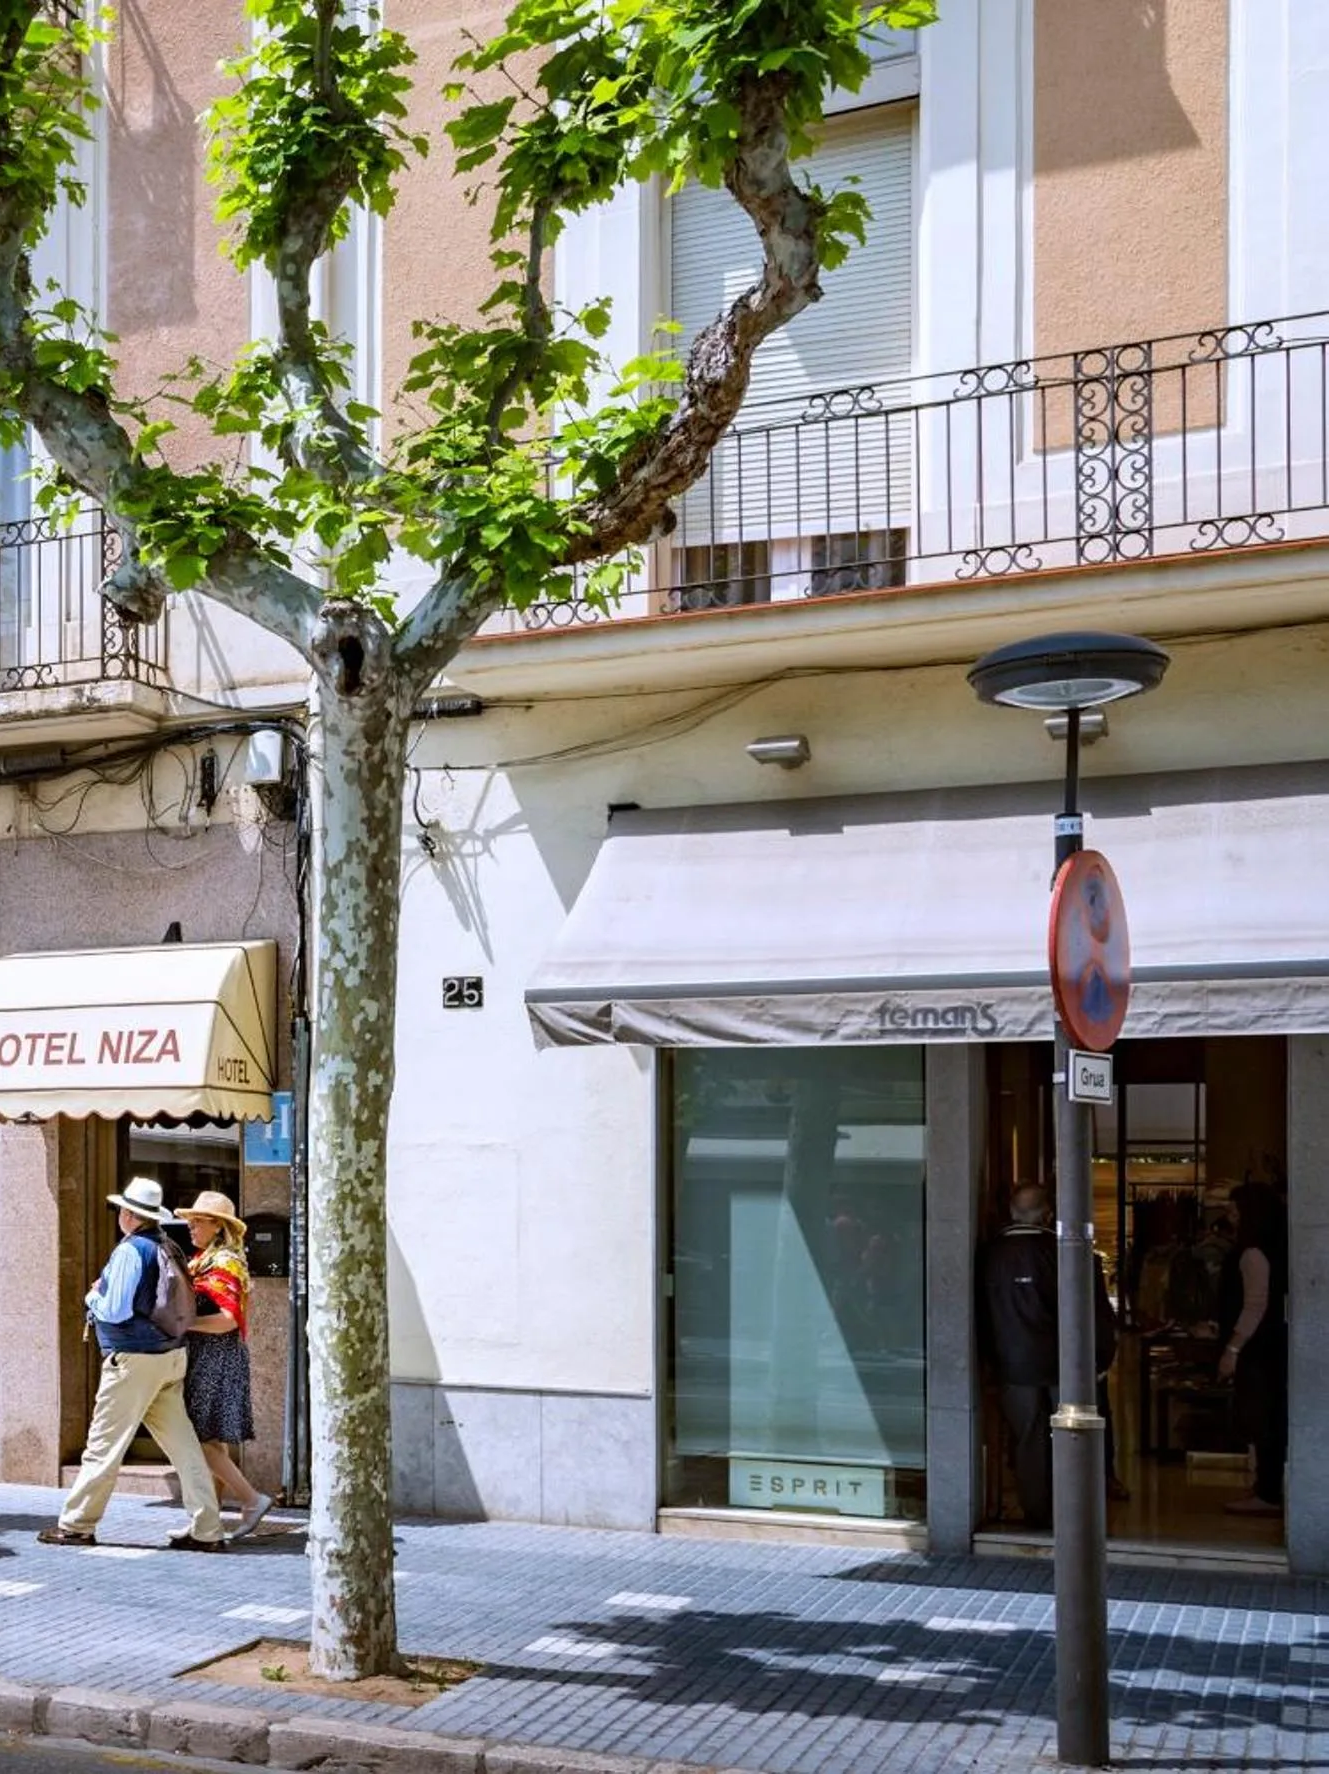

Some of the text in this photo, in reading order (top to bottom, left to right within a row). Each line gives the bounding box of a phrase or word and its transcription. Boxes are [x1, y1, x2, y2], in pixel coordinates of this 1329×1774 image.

[444, 978, 479, 1005] 25
[97, 1029, 181, 1064] NIZA
[217, 1056, 250, 1084] HOTEL
[1081, 1067, 1105, 1088] Grua
[749, 1474, 862, 1497] ESPRIT
